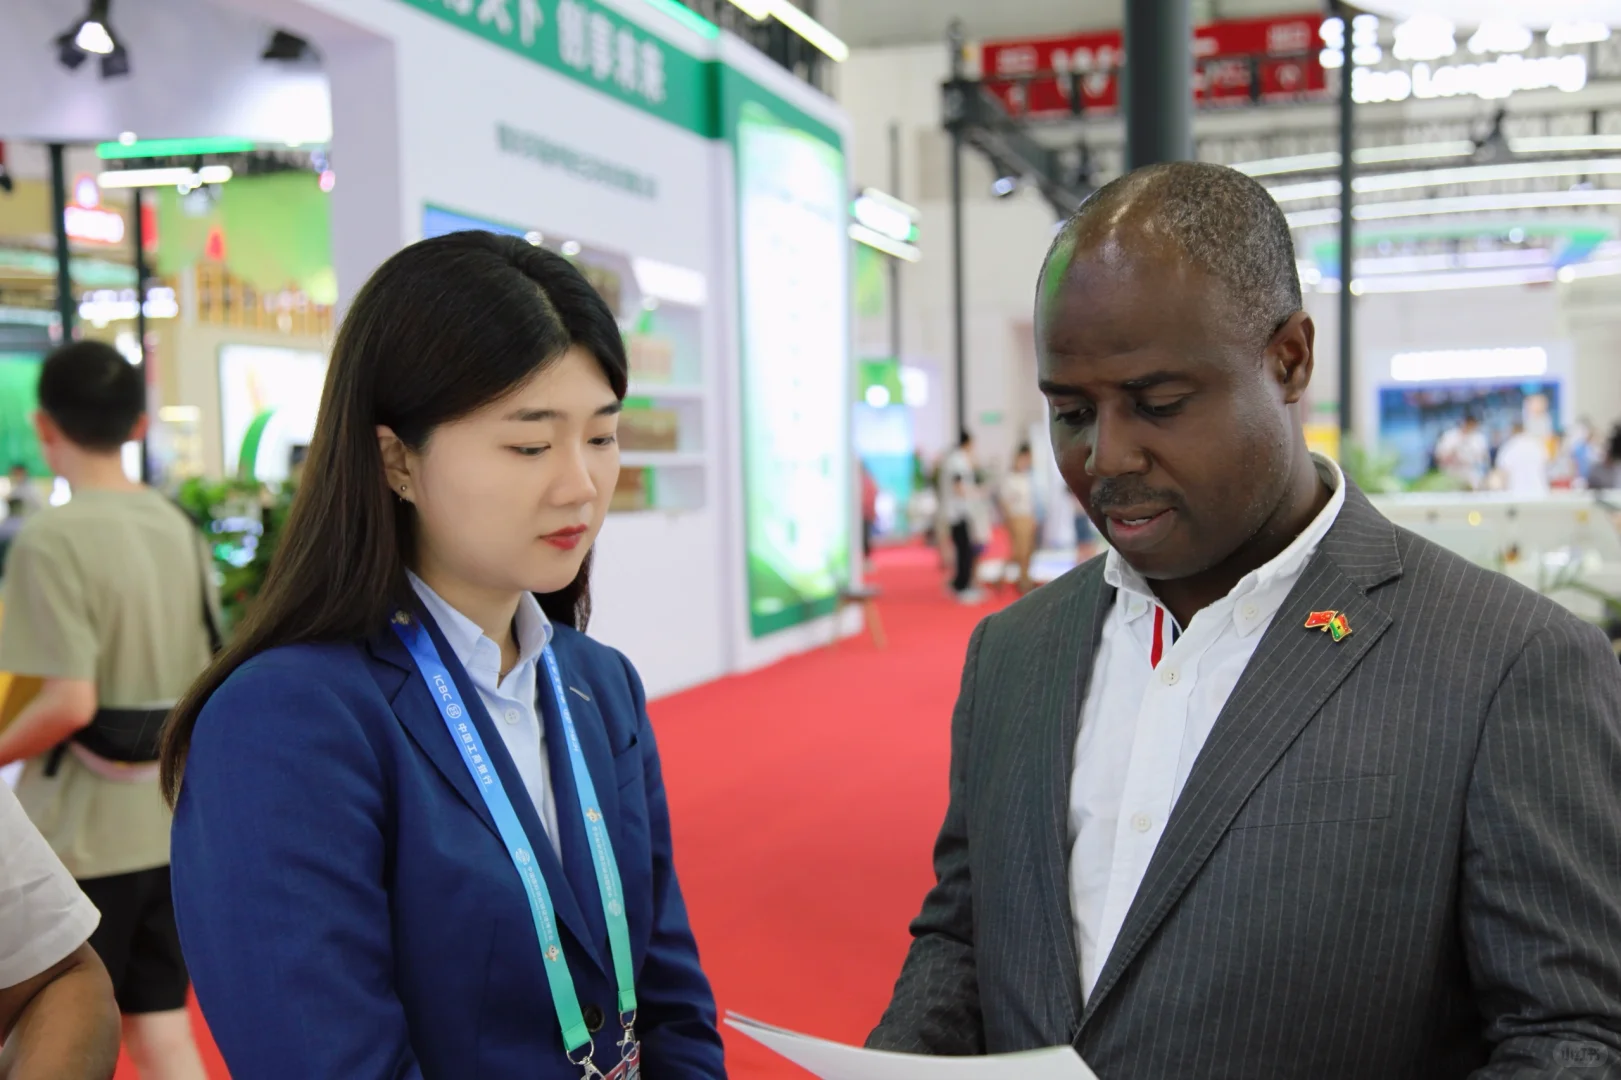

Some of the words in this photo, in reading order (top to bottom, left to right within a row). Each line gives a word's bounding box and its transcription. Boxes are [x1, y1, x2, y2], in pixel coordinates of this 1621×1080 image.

[432, 674, 453, 702] ICBC
[456, 722, 494, 786] 中国工商银行
